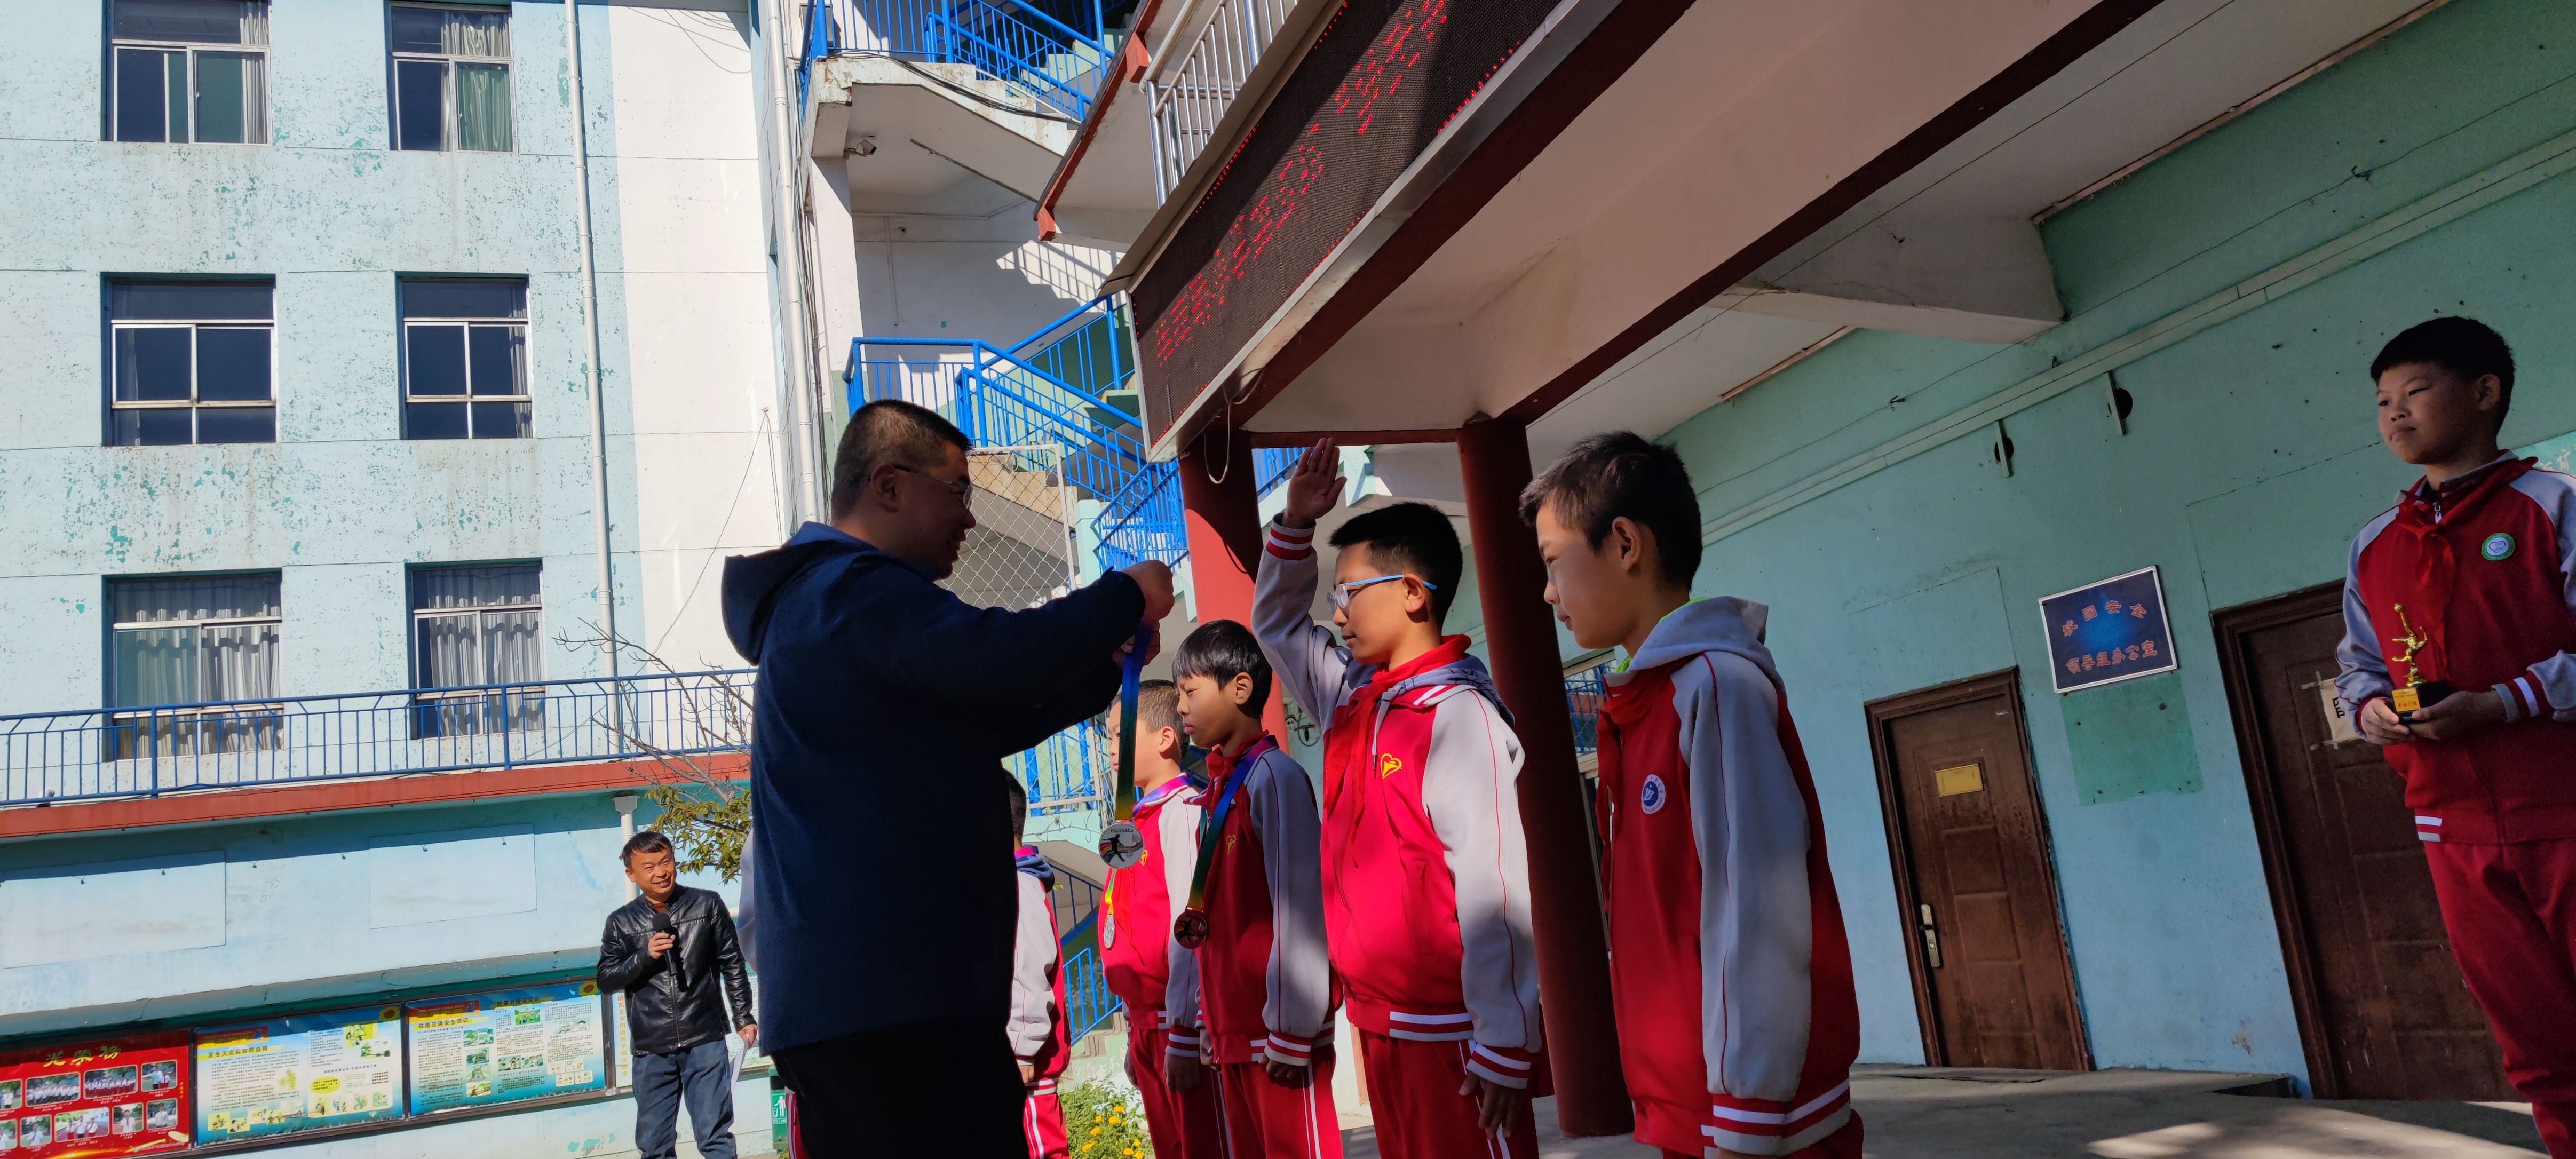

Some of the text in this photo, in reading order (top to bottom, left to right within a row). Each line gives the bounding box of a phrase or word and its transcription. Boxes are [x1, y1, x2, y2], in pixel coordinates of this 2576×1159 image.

[2062, 599, 2147, 637] 校园安全
[2066, 639, 2158, 674] 领导组办公室
[418, 1018, 469, 1029] 铁路交通安全常识
[617, 995, 628, 1077] 语言文字用语用字规范要求
[42, 1045, 122, 1068] 光荣榜
[208, 1045, 268, 1059] 发生火灾后如何自救
